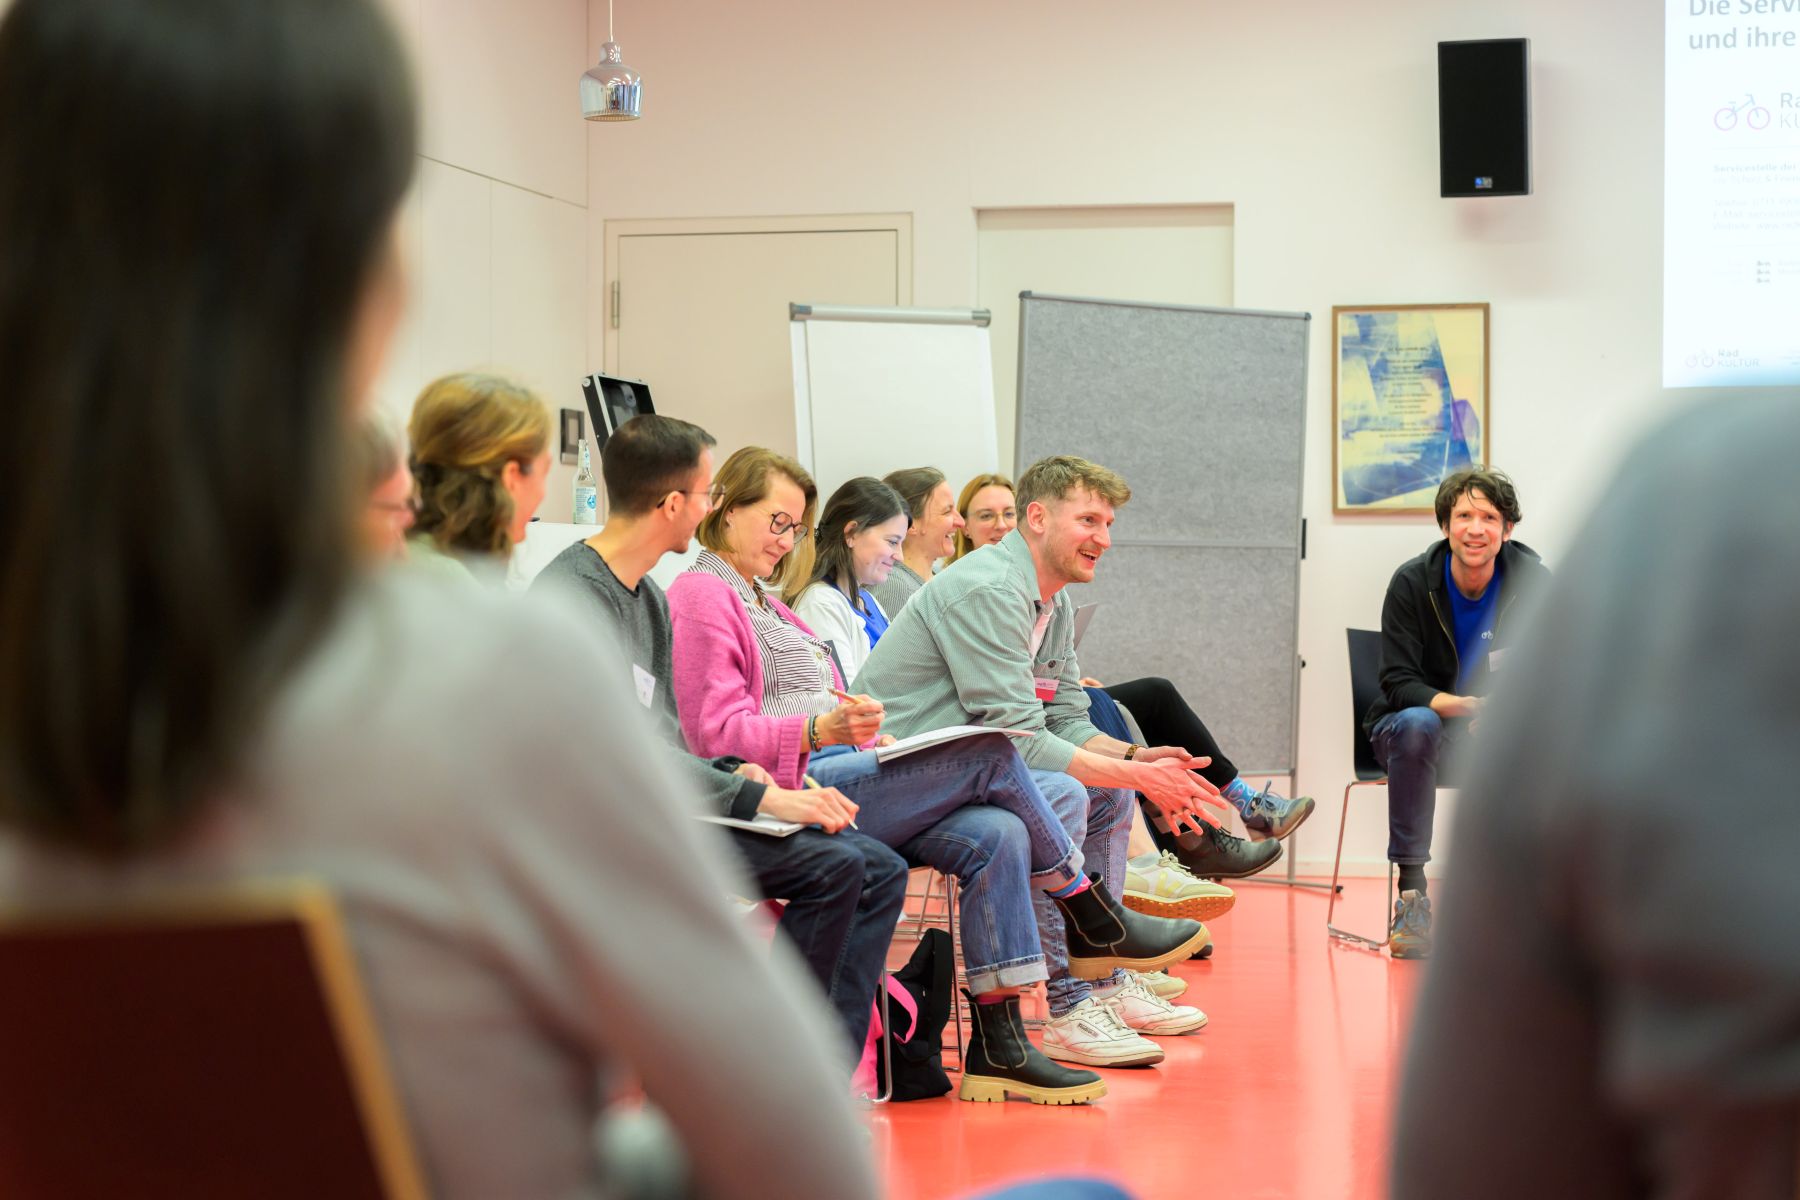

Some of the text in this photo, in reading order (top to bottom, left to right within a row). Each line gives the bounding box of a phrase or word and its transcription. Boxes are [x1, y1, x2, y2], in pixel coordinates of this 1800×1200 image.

[1689, 0, 1731, 16] Die
[1689, 25, 1796, 50] und ihre
[1718, 348, 1739, 357] Rad
